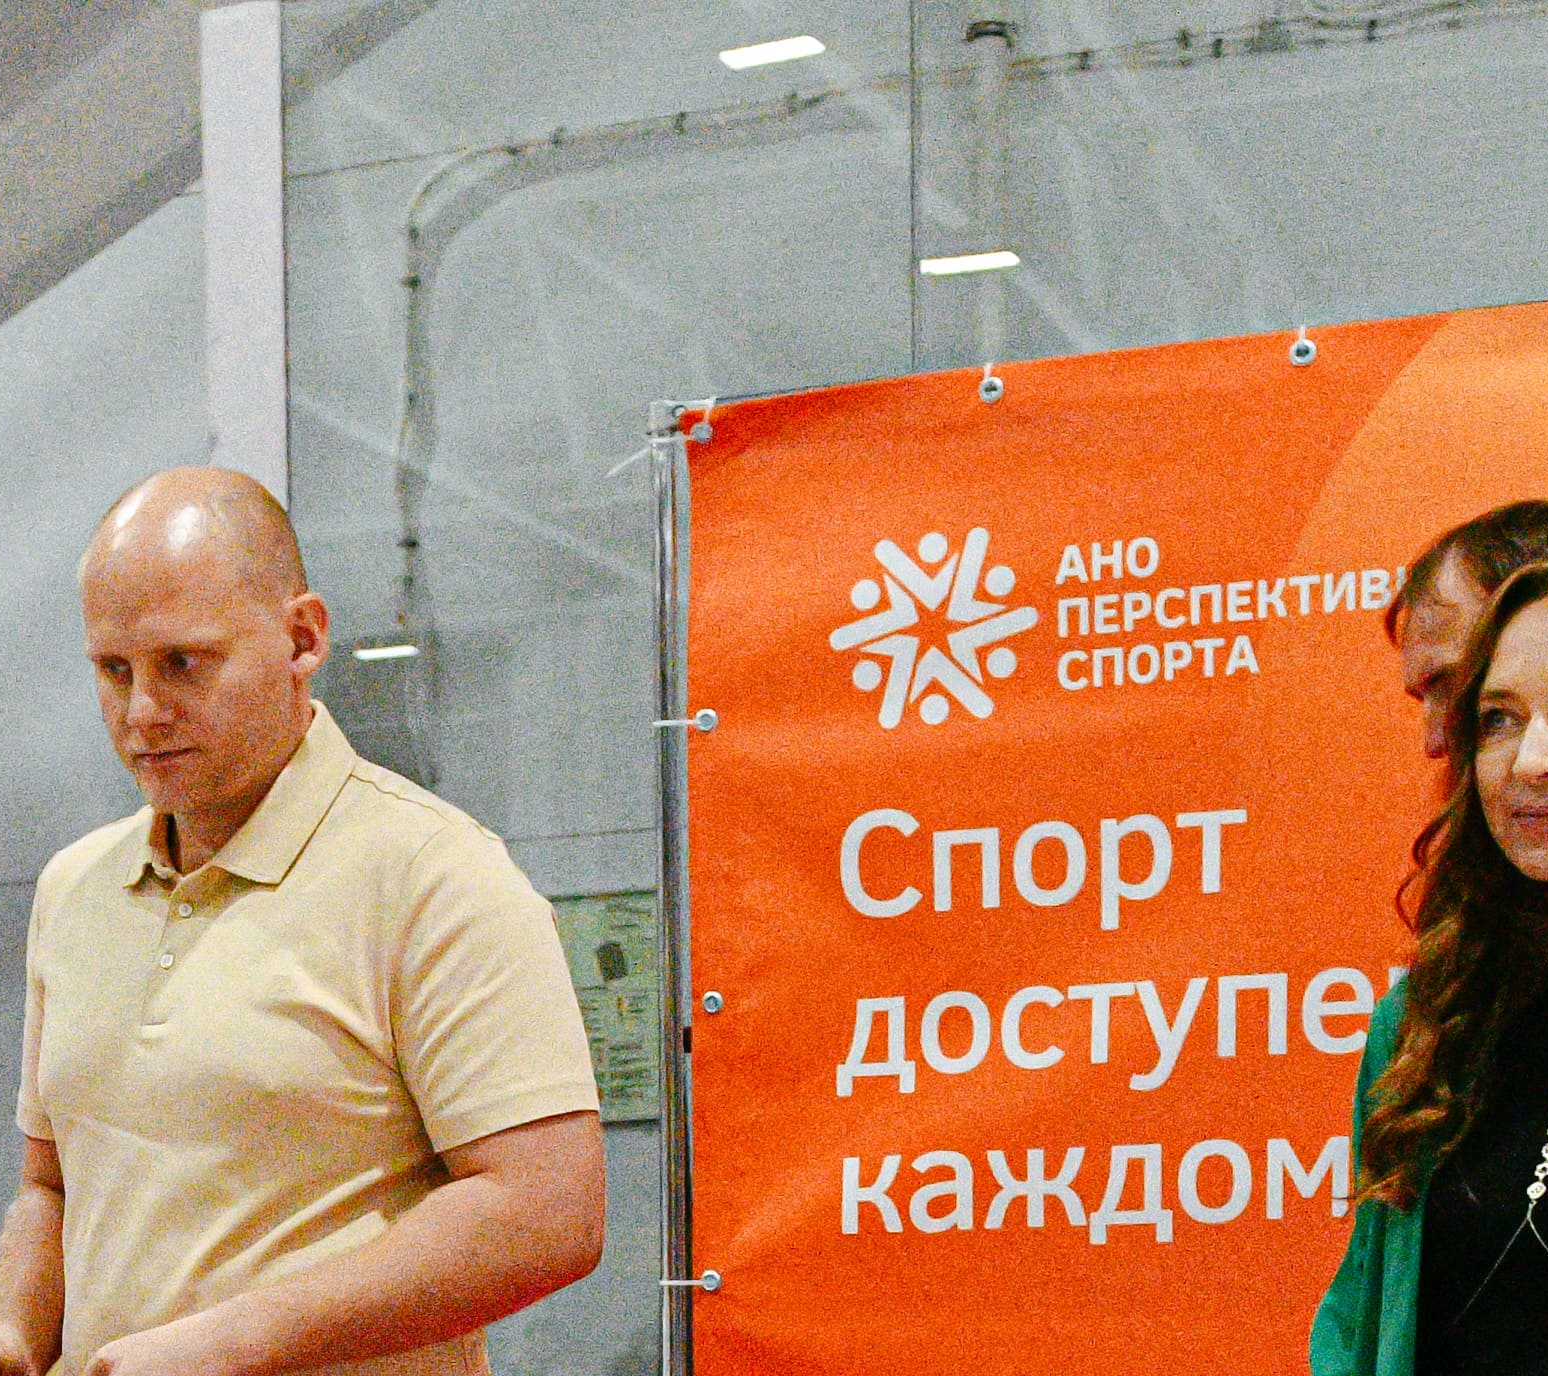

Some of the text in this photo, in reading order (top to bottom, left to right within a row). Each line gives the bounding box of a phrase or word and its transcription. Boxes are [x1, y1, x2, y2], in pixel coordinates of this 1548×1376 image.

[1056, 537, 1160, 584] АНО
[1057, 635, 1260, 691] СПОРТА
[840, 809, 1248, 930] Спорт
[837, 966, 1409, 1096] доступе
[842, 1135, 1350, 1244] каждом
